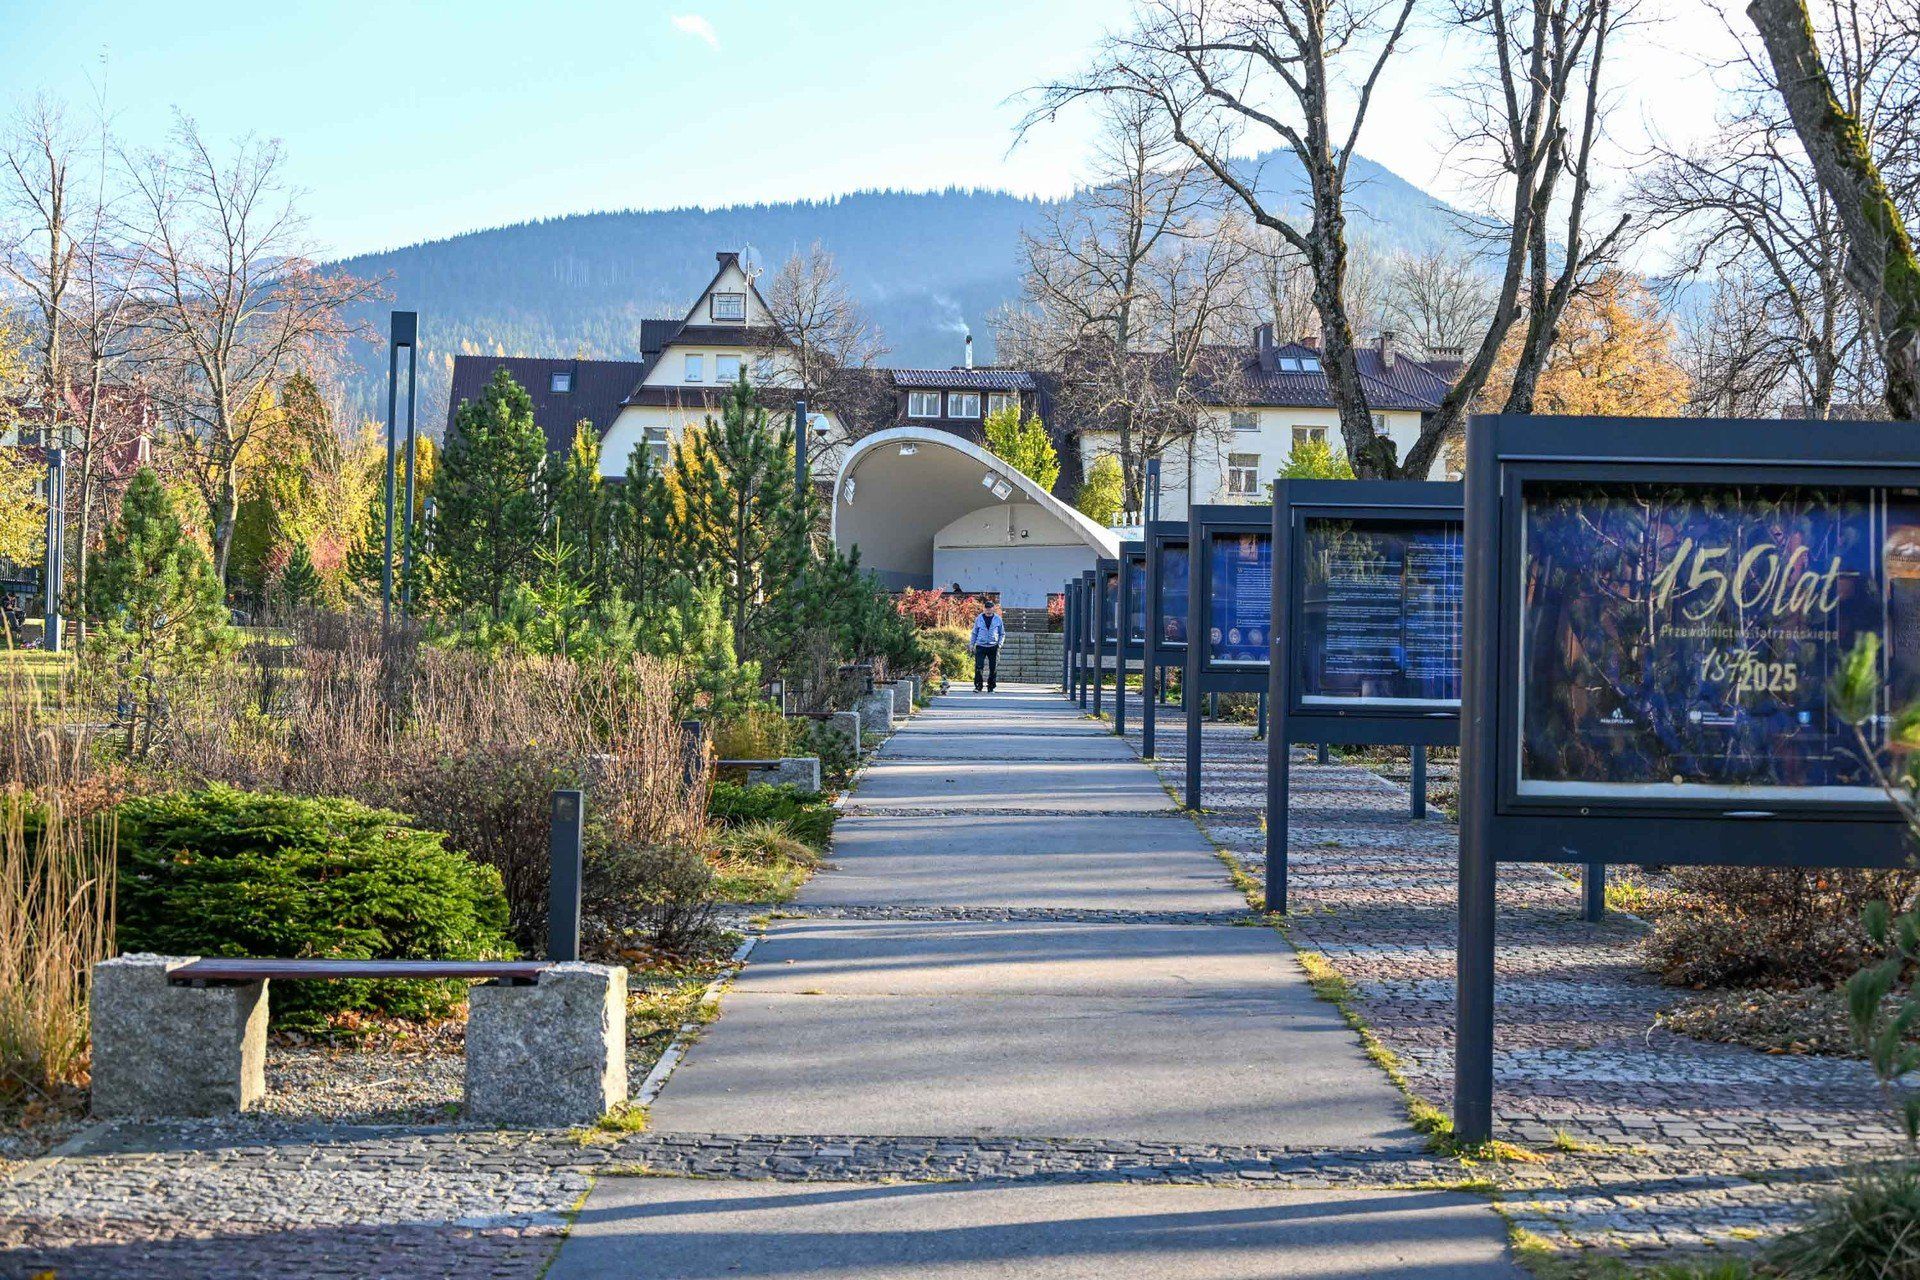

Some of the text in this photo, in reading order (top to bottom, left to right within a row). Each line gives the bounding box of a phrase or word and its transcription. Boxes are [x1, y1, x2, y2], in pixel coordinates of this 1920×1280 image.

[1652, 537, 1860, 620] 150 lat
[1739, 663, 1797, 692] 2025
